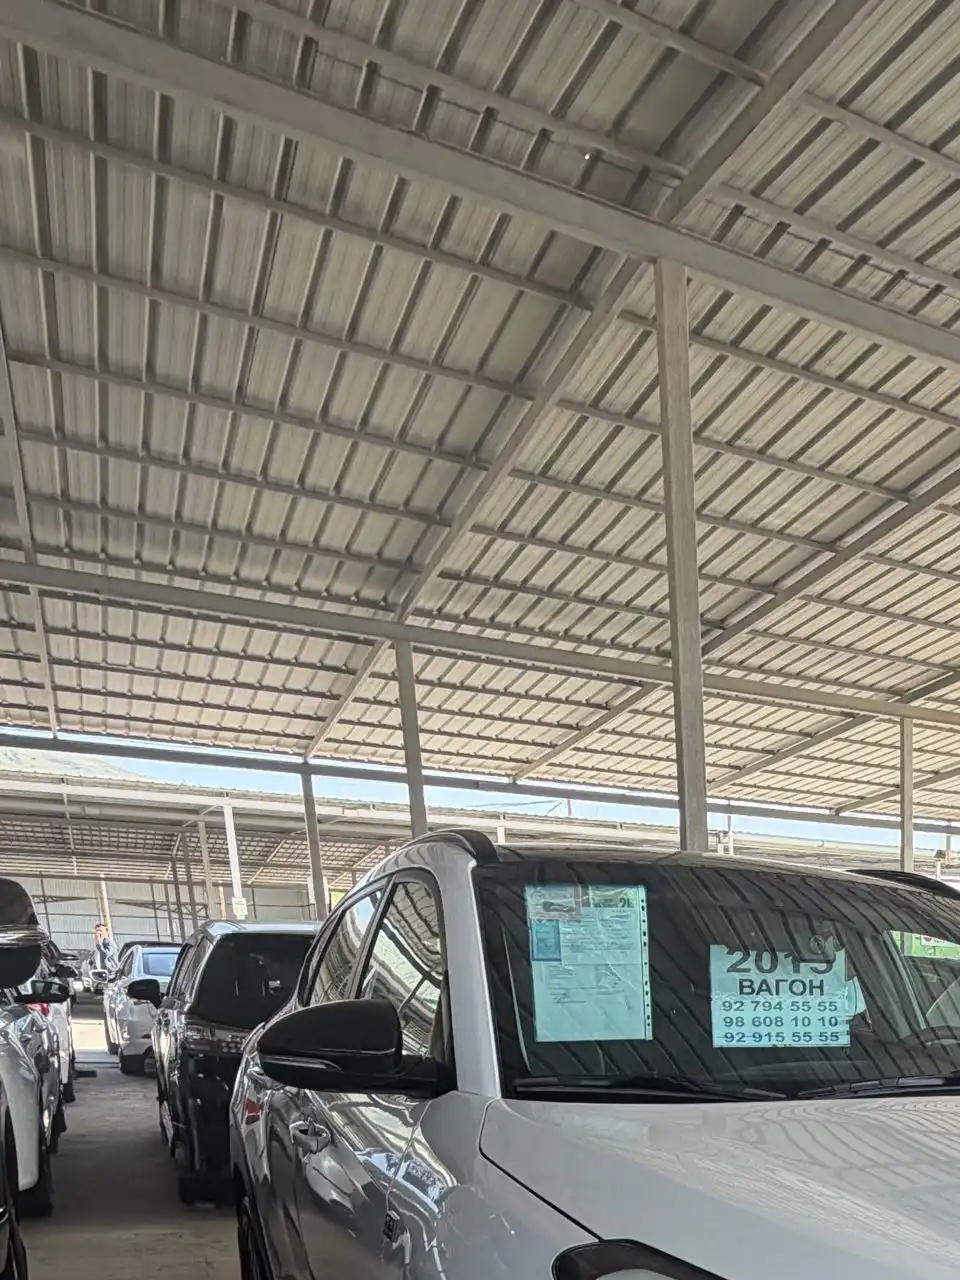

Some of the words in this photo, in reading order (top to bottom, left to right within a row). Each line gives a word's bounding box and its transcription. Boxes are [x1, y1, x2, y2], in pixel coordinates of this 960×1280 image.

[738, 978, 824, 997] ВАГОН
[722, 1000, 745, 1012] 92
[750, 1000, 784, 1012] 794
[790, 1000, 811, 1012] 55
[816, 1000, 838, 1012] 55
[723, 1016, 745, 1028] 98
[751, 1016, 784, 1028] 608
[791, 1016, 811, 1028] 10
[817, 1016, 838, 1028] 10
[724, 1031, 746, 1043] 92
[752, 1031, 785, 1043] 915
[791, 1031, 812, 1043] 55
[818, 1031, 840, 1043] 55
